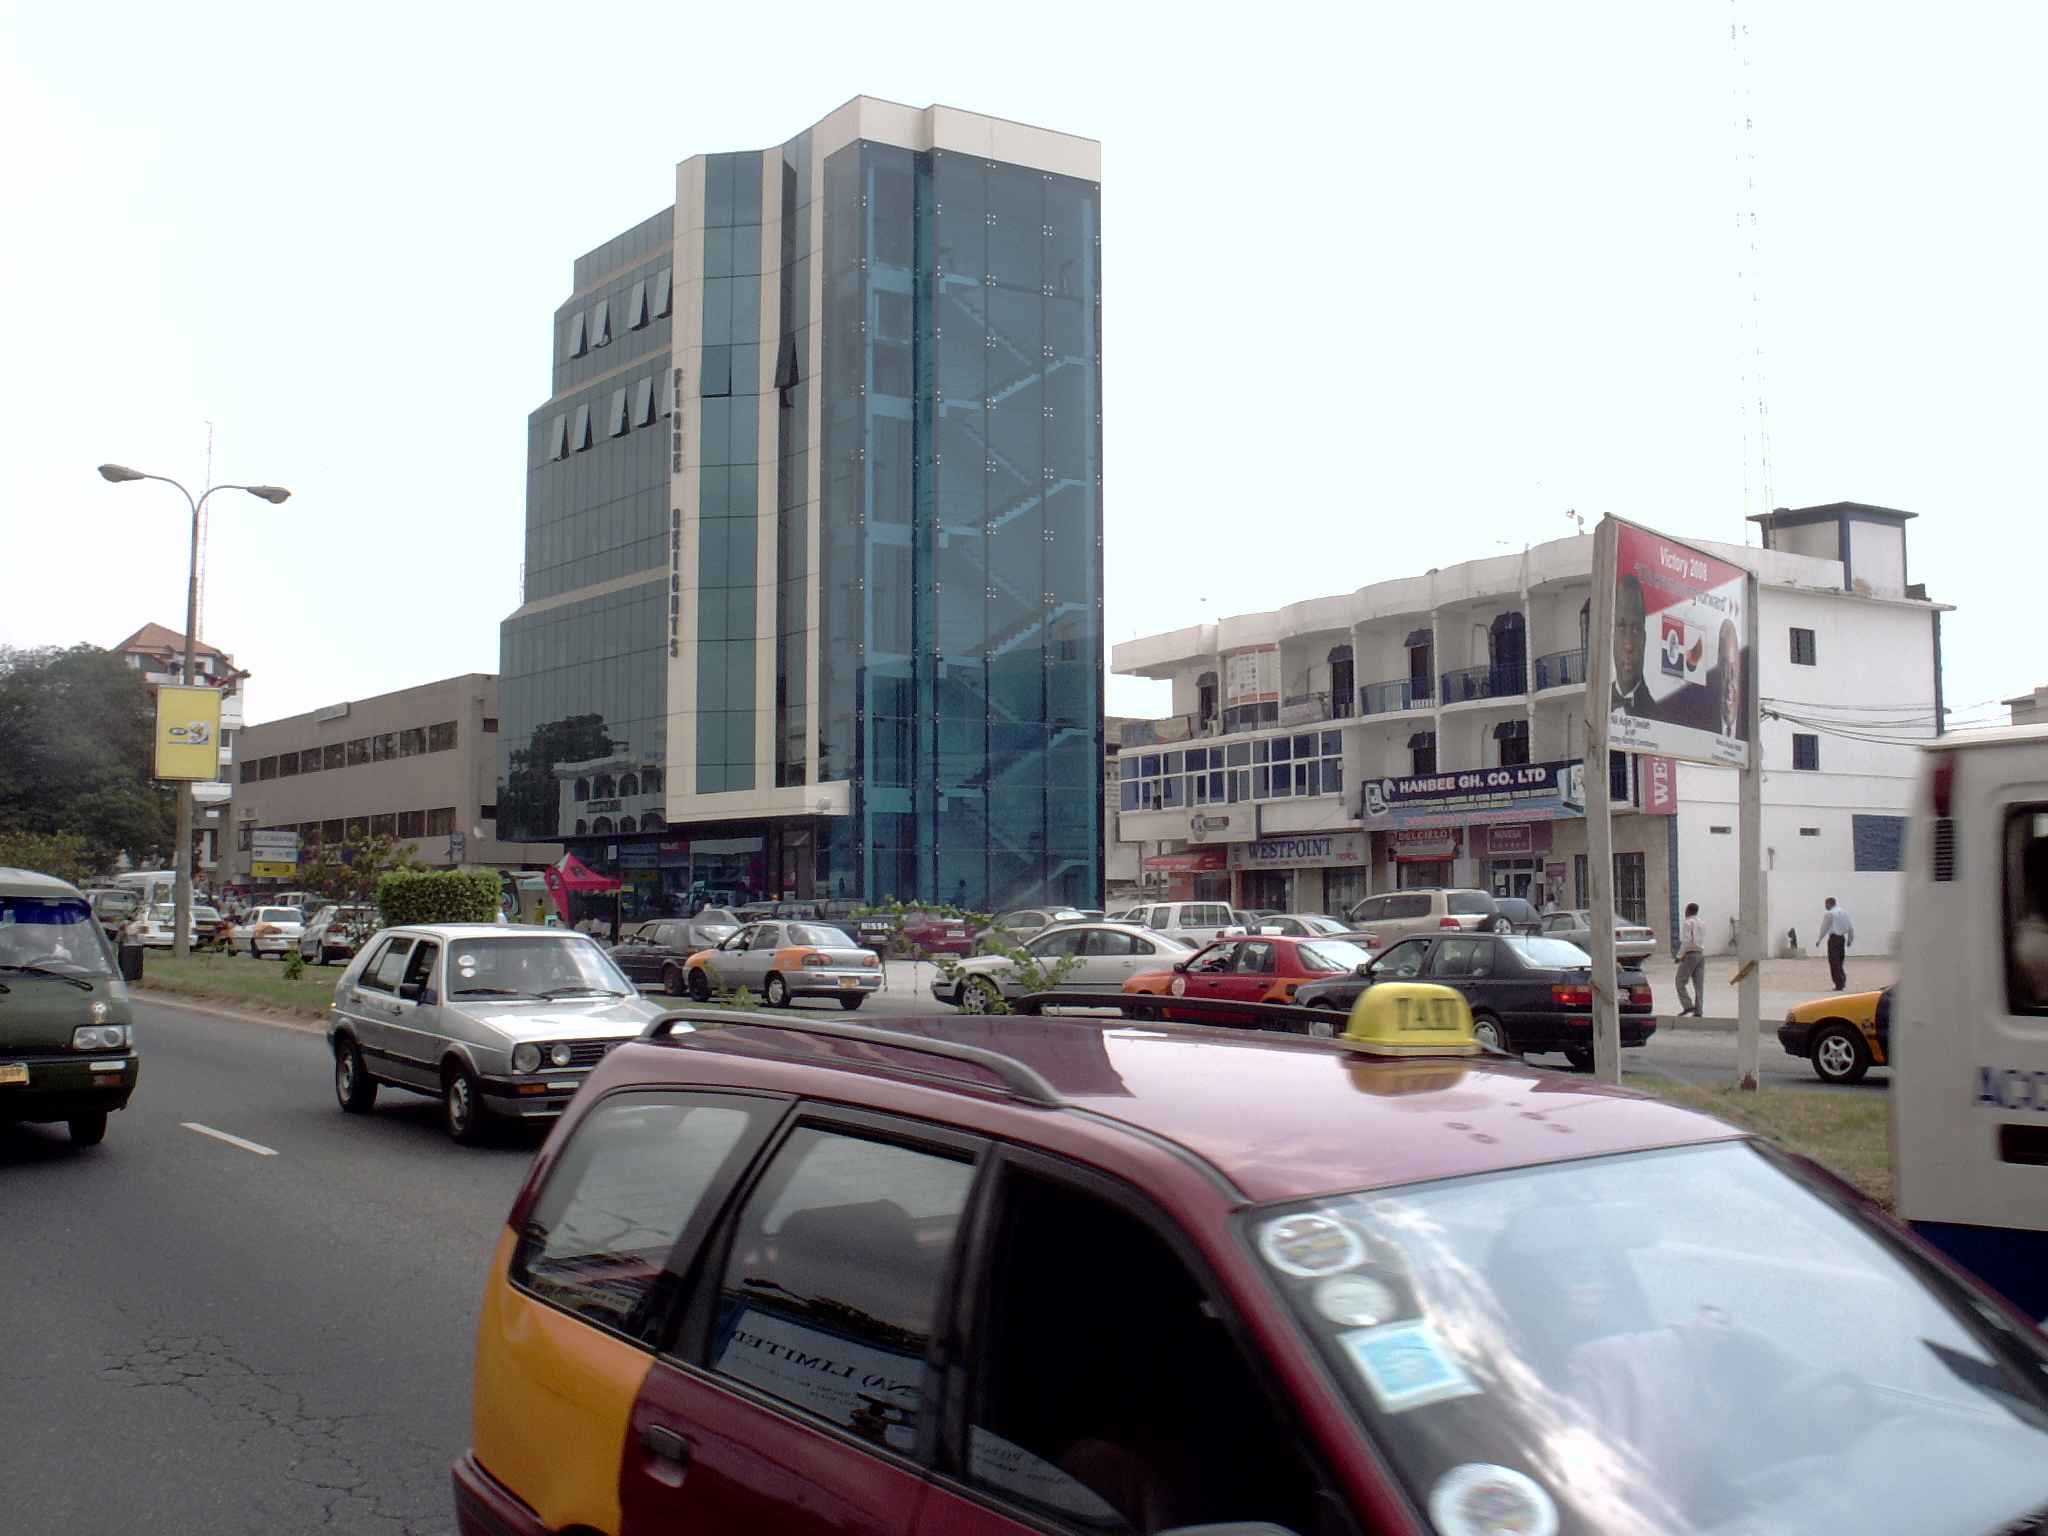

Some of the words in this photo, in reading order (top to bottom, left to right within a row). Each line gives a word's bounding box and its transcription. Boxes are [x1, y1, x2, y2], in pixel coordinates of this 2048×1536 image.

[1399, 777, 1456, 794] HANBEE
[1458, 773, 1484, 789] GH.
[1487, 770, 1514, 786] CO.
[1517, 767, 1546, 784] LTD
[1248, 837, 1332, 860] WESTPOINT
[1396, 996, 1459, 1031] TAXI
